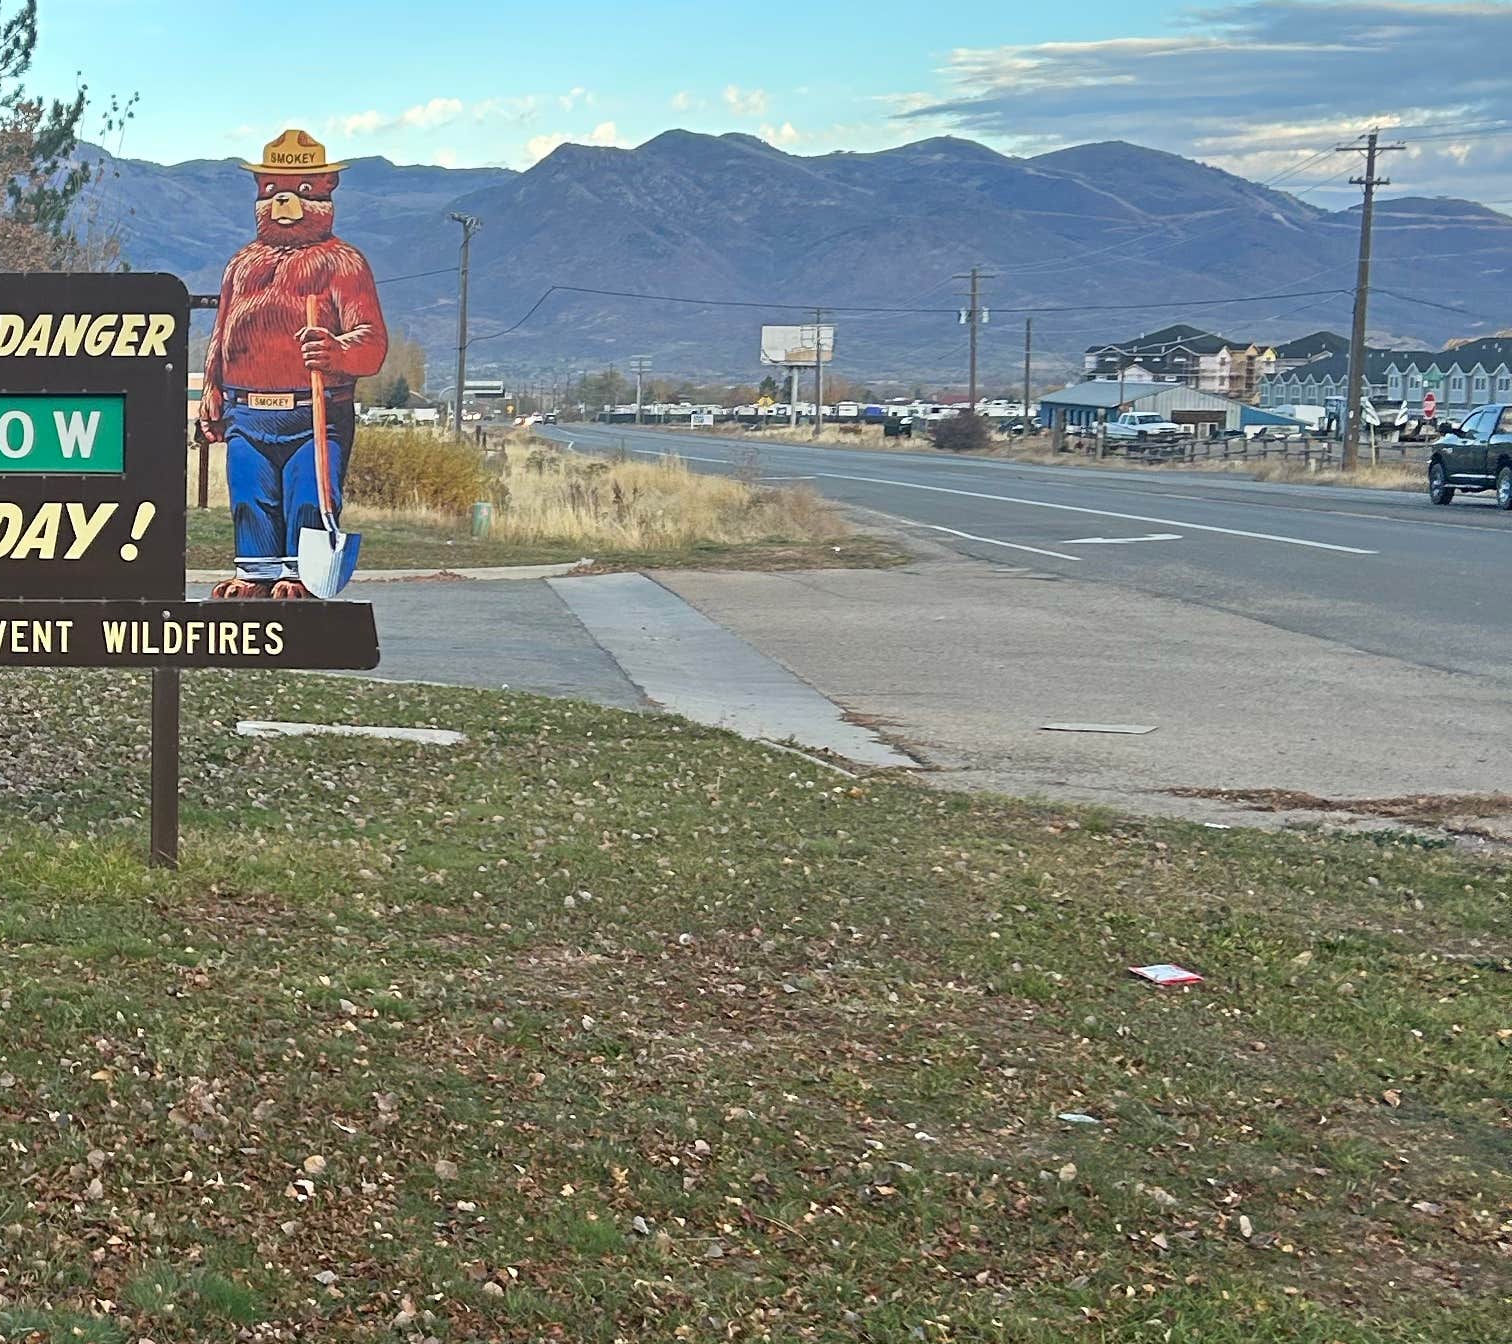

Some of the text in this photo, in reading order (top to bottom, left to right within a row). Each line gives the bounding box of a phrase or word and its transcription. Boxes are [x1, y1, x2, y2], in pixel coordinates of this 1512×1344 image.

[270, 152, 316, 164] SMOKEY
[255, 397, 289, 406] SMOKEY
[103, 621, 284, 655] WILDFIRES
